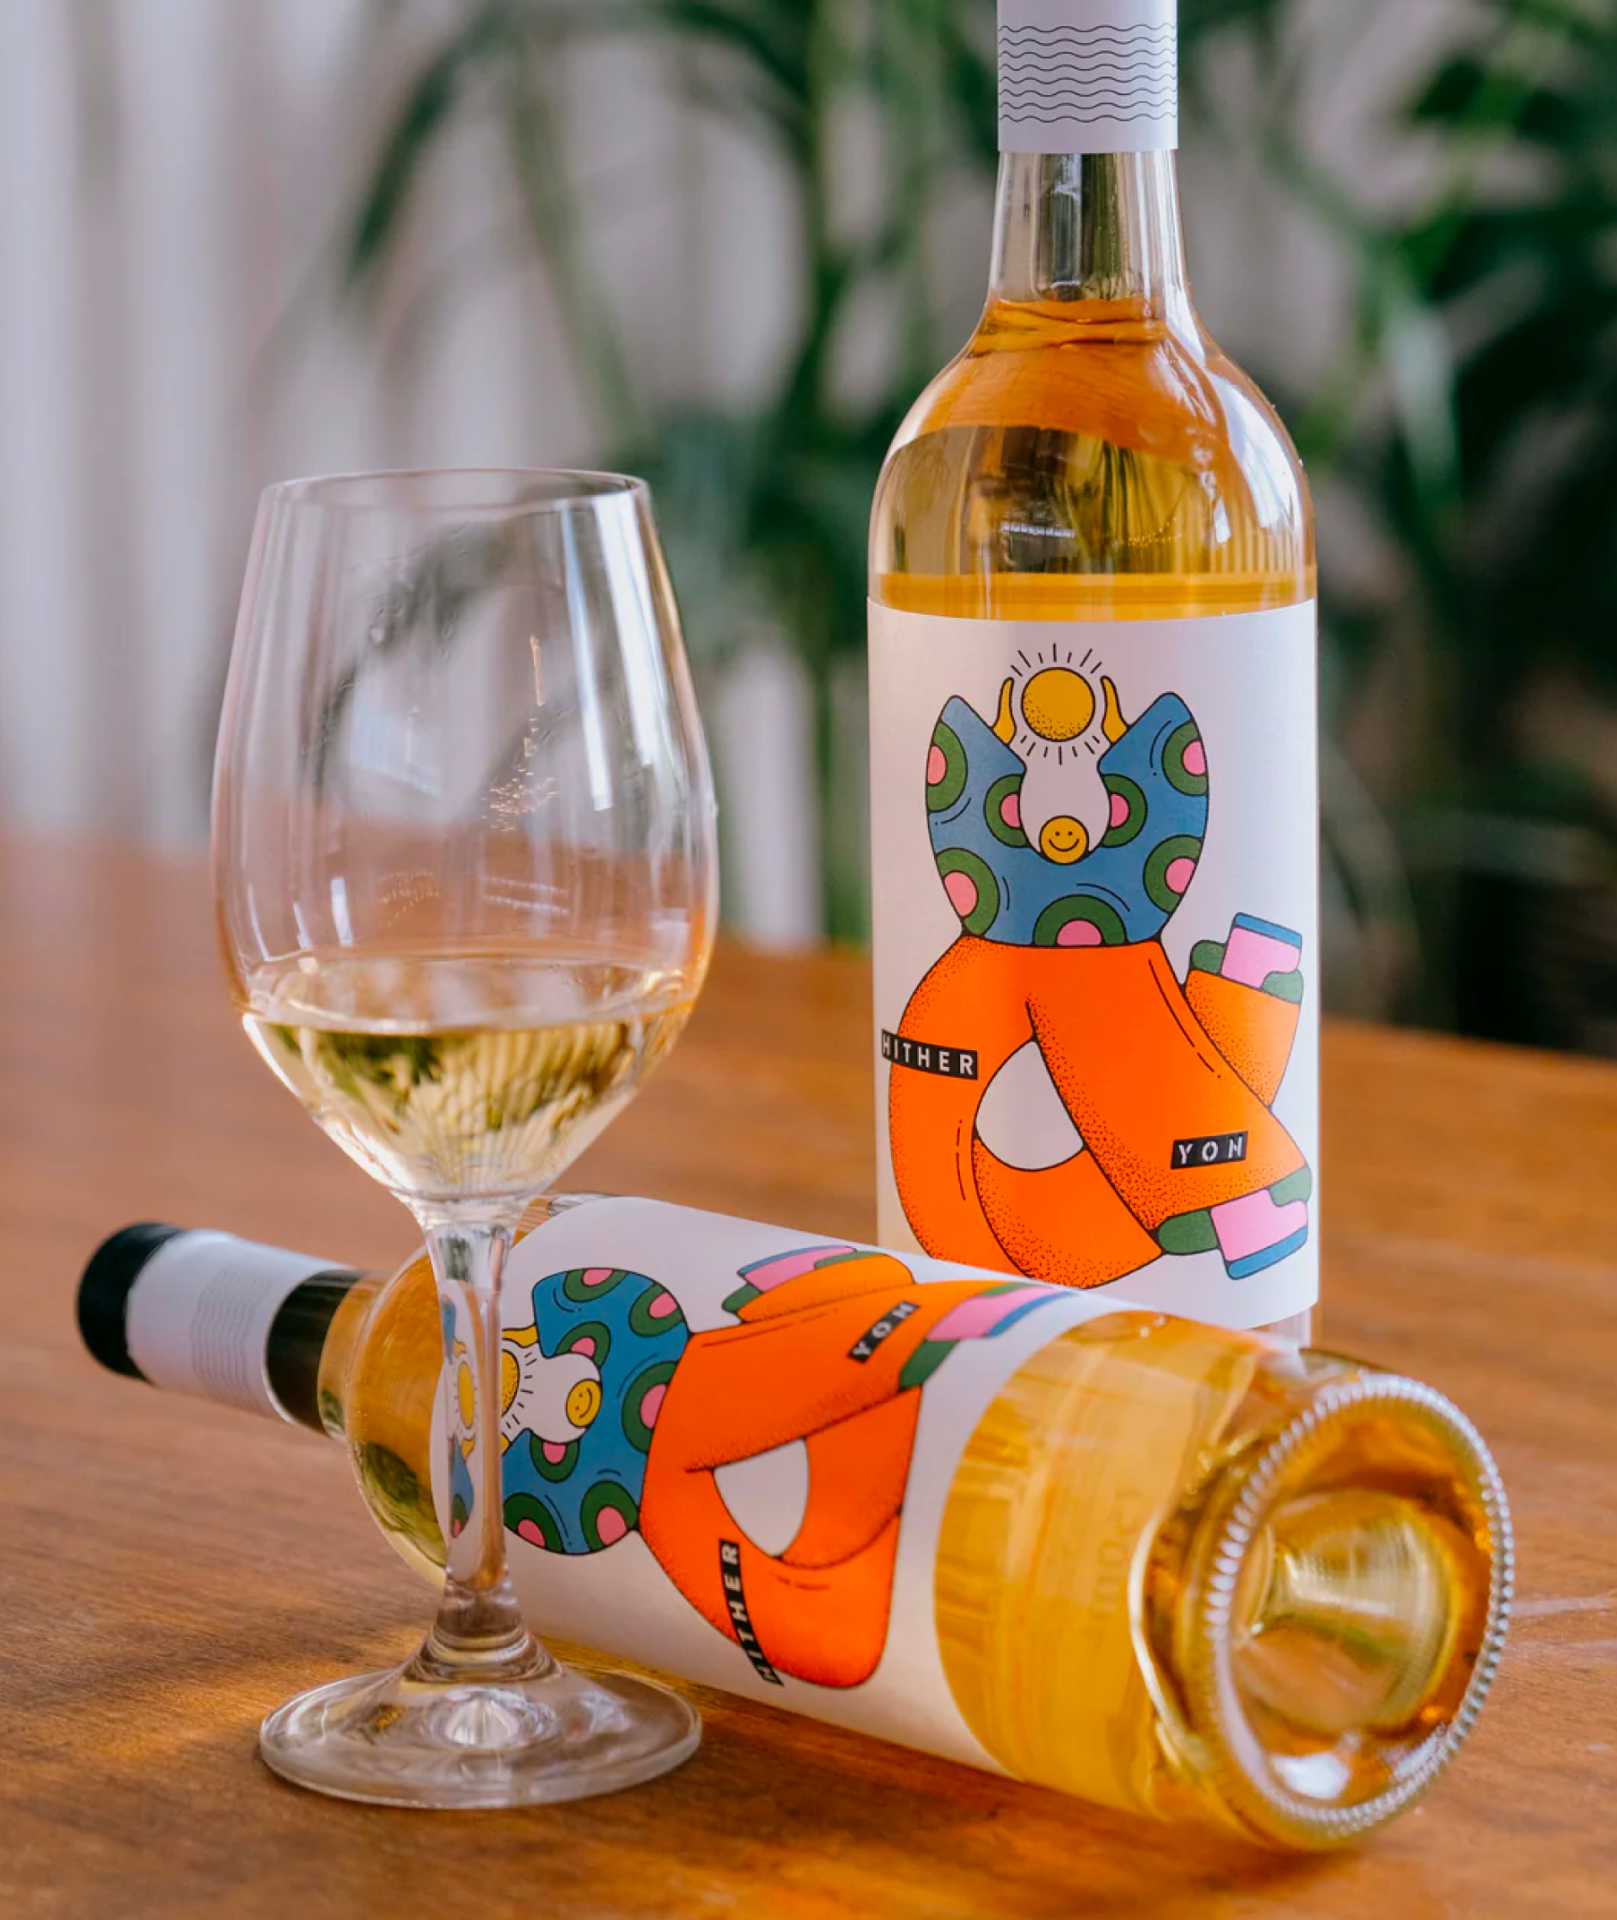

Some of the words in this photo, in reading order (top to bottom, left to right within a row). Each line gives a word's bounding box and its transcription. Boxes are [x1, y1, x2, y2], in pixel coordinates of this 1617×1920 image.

[882, 1033, 975, 1076] HITHER
[1178, 1135, 1243, 1165] YON
[851, 1302, 916, 1356] YON
